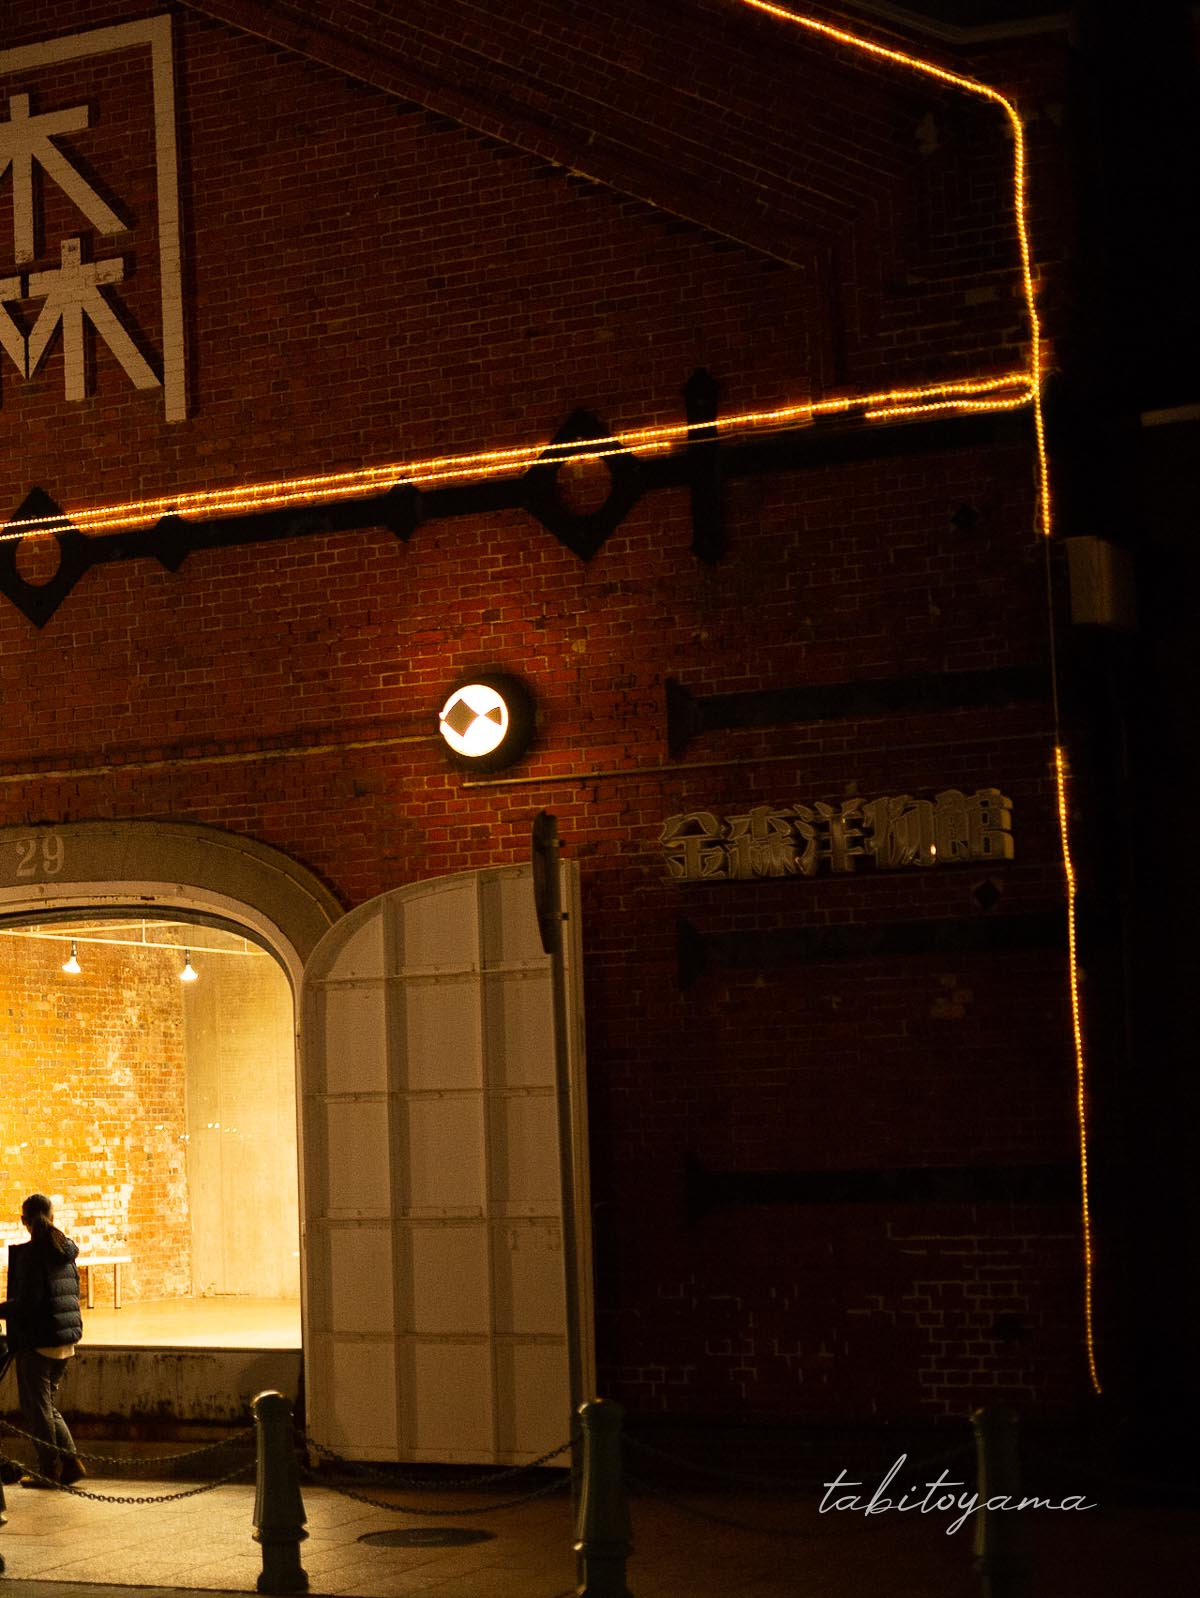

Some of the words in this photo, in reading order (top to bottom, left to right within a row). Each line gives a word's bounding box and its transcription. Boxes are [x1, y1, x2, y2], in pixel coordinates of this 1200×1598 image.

[15, 835, 65, 877] 29
[658, 787, 1015, 881] 金森洋物館
